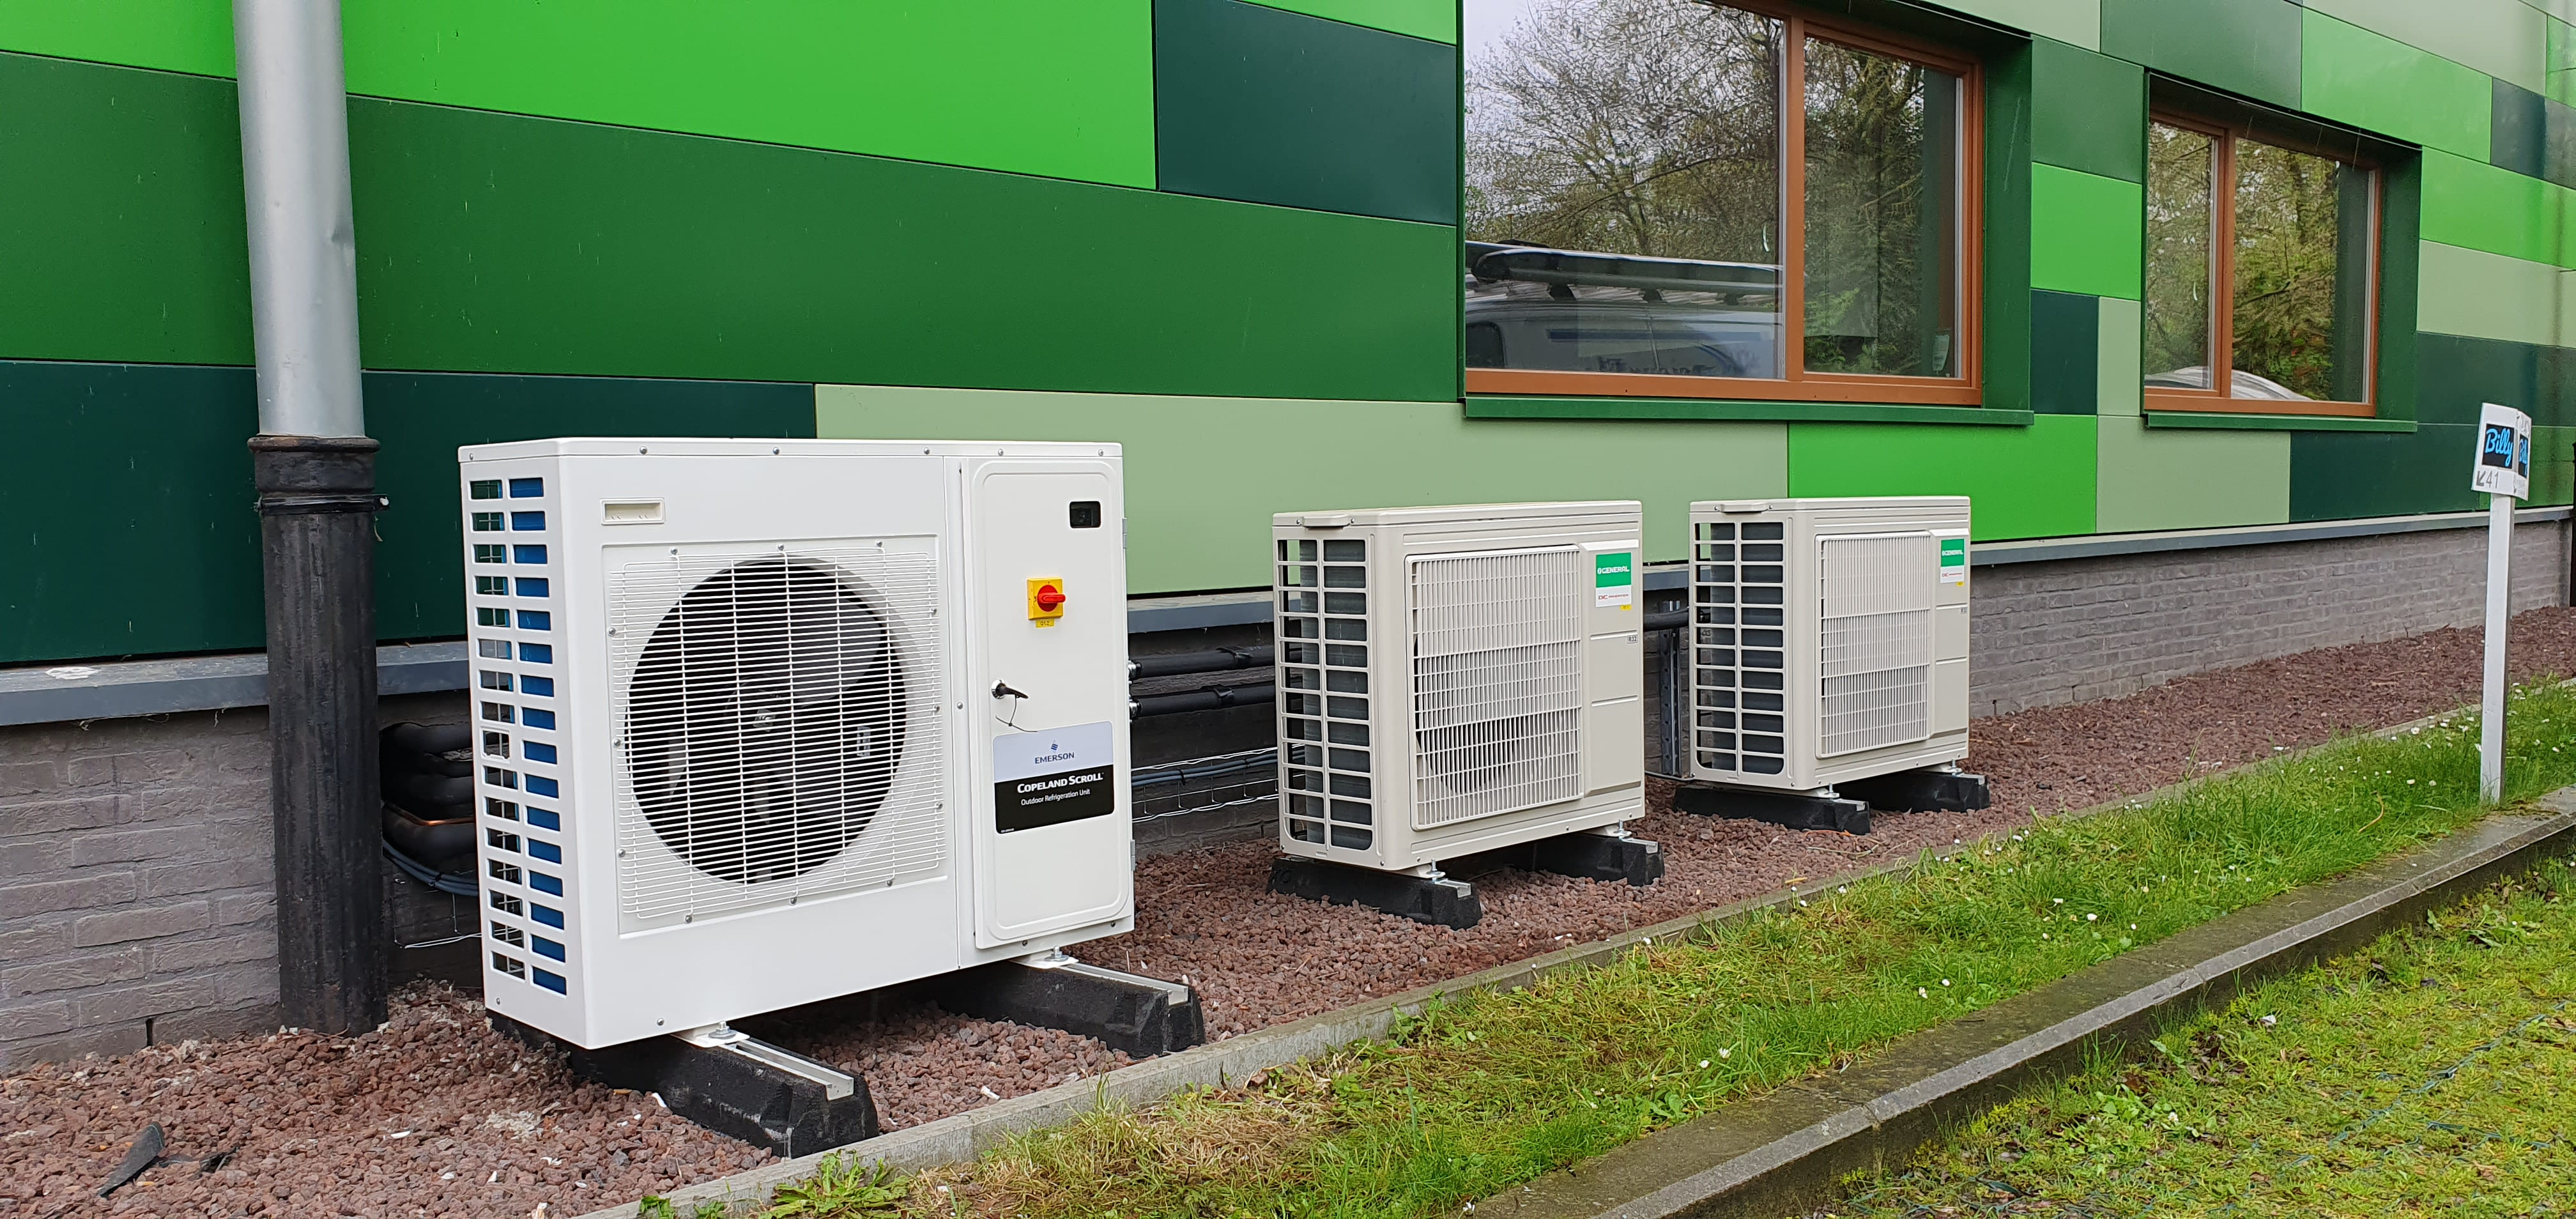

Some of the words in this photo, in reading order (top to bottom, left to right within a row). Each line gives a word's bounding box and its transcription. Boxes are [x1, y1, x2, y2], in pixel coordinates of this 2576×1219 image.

[2485, 428, 2513, 467] Billy
[1034, 752, 1075, 764] EMERSON
[1017, 778, 1068, 793] COPELAND
[1021, 797, 1044, 806] Outdoor
[1045, 792, 1078, 802] Refrigeration
